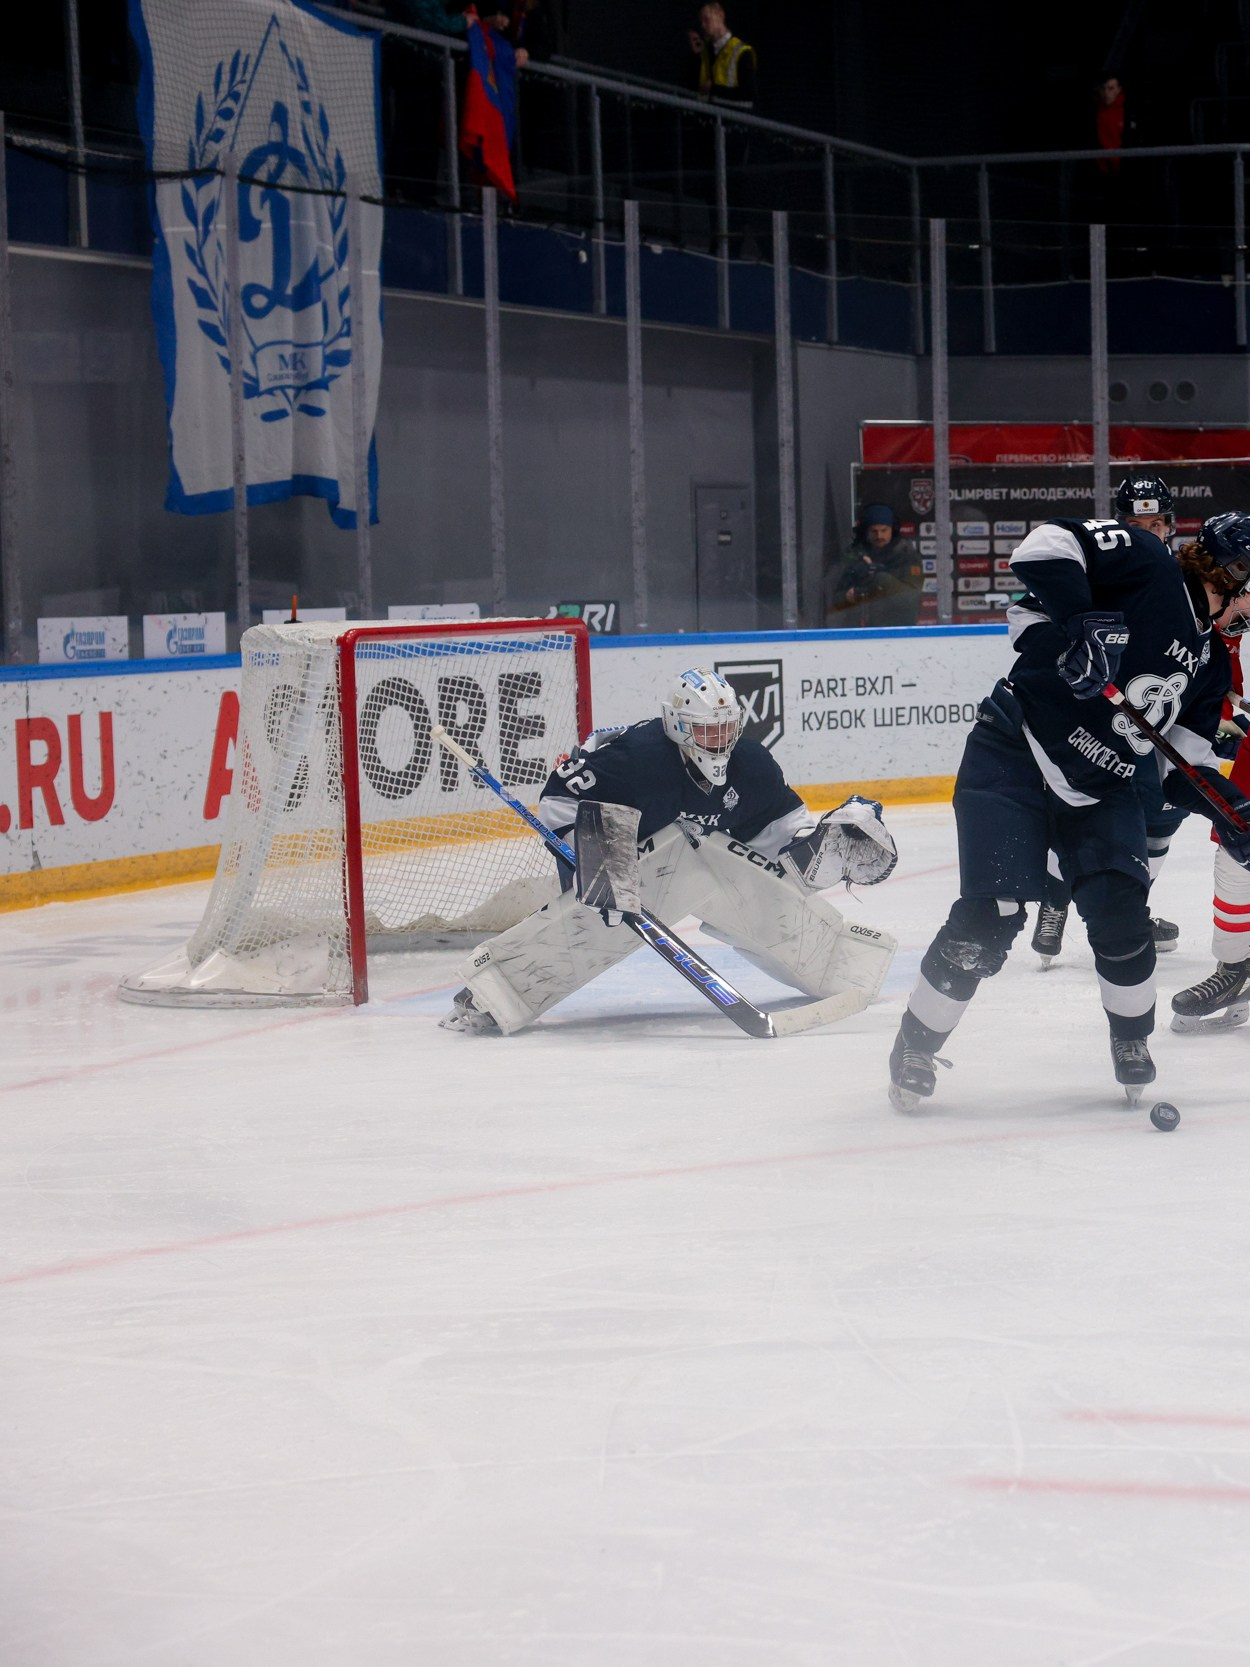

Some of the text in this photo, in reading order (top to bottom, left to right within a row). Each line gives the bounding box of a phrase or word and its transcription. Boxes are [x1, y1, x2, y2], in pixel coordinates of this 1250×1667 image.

[1180, 485, 1213, 498] ЛИГА
[1082, 519, 1132, 551] 45
[1164, 639, 1200, 678] МХ
[801, 677, 847, 700] PARI
[855, 675, 894, 697] ВХЛ
[801, 708, 866, 732] КУБОК
[873, 703, 981, 727] ШЕЛКОВО
[556, 758, 597, 796] 32
[712, 765, 727, 778] 32
[727, 840, 788, 879] CCM
[809, 850, 825, 882] BAUER
